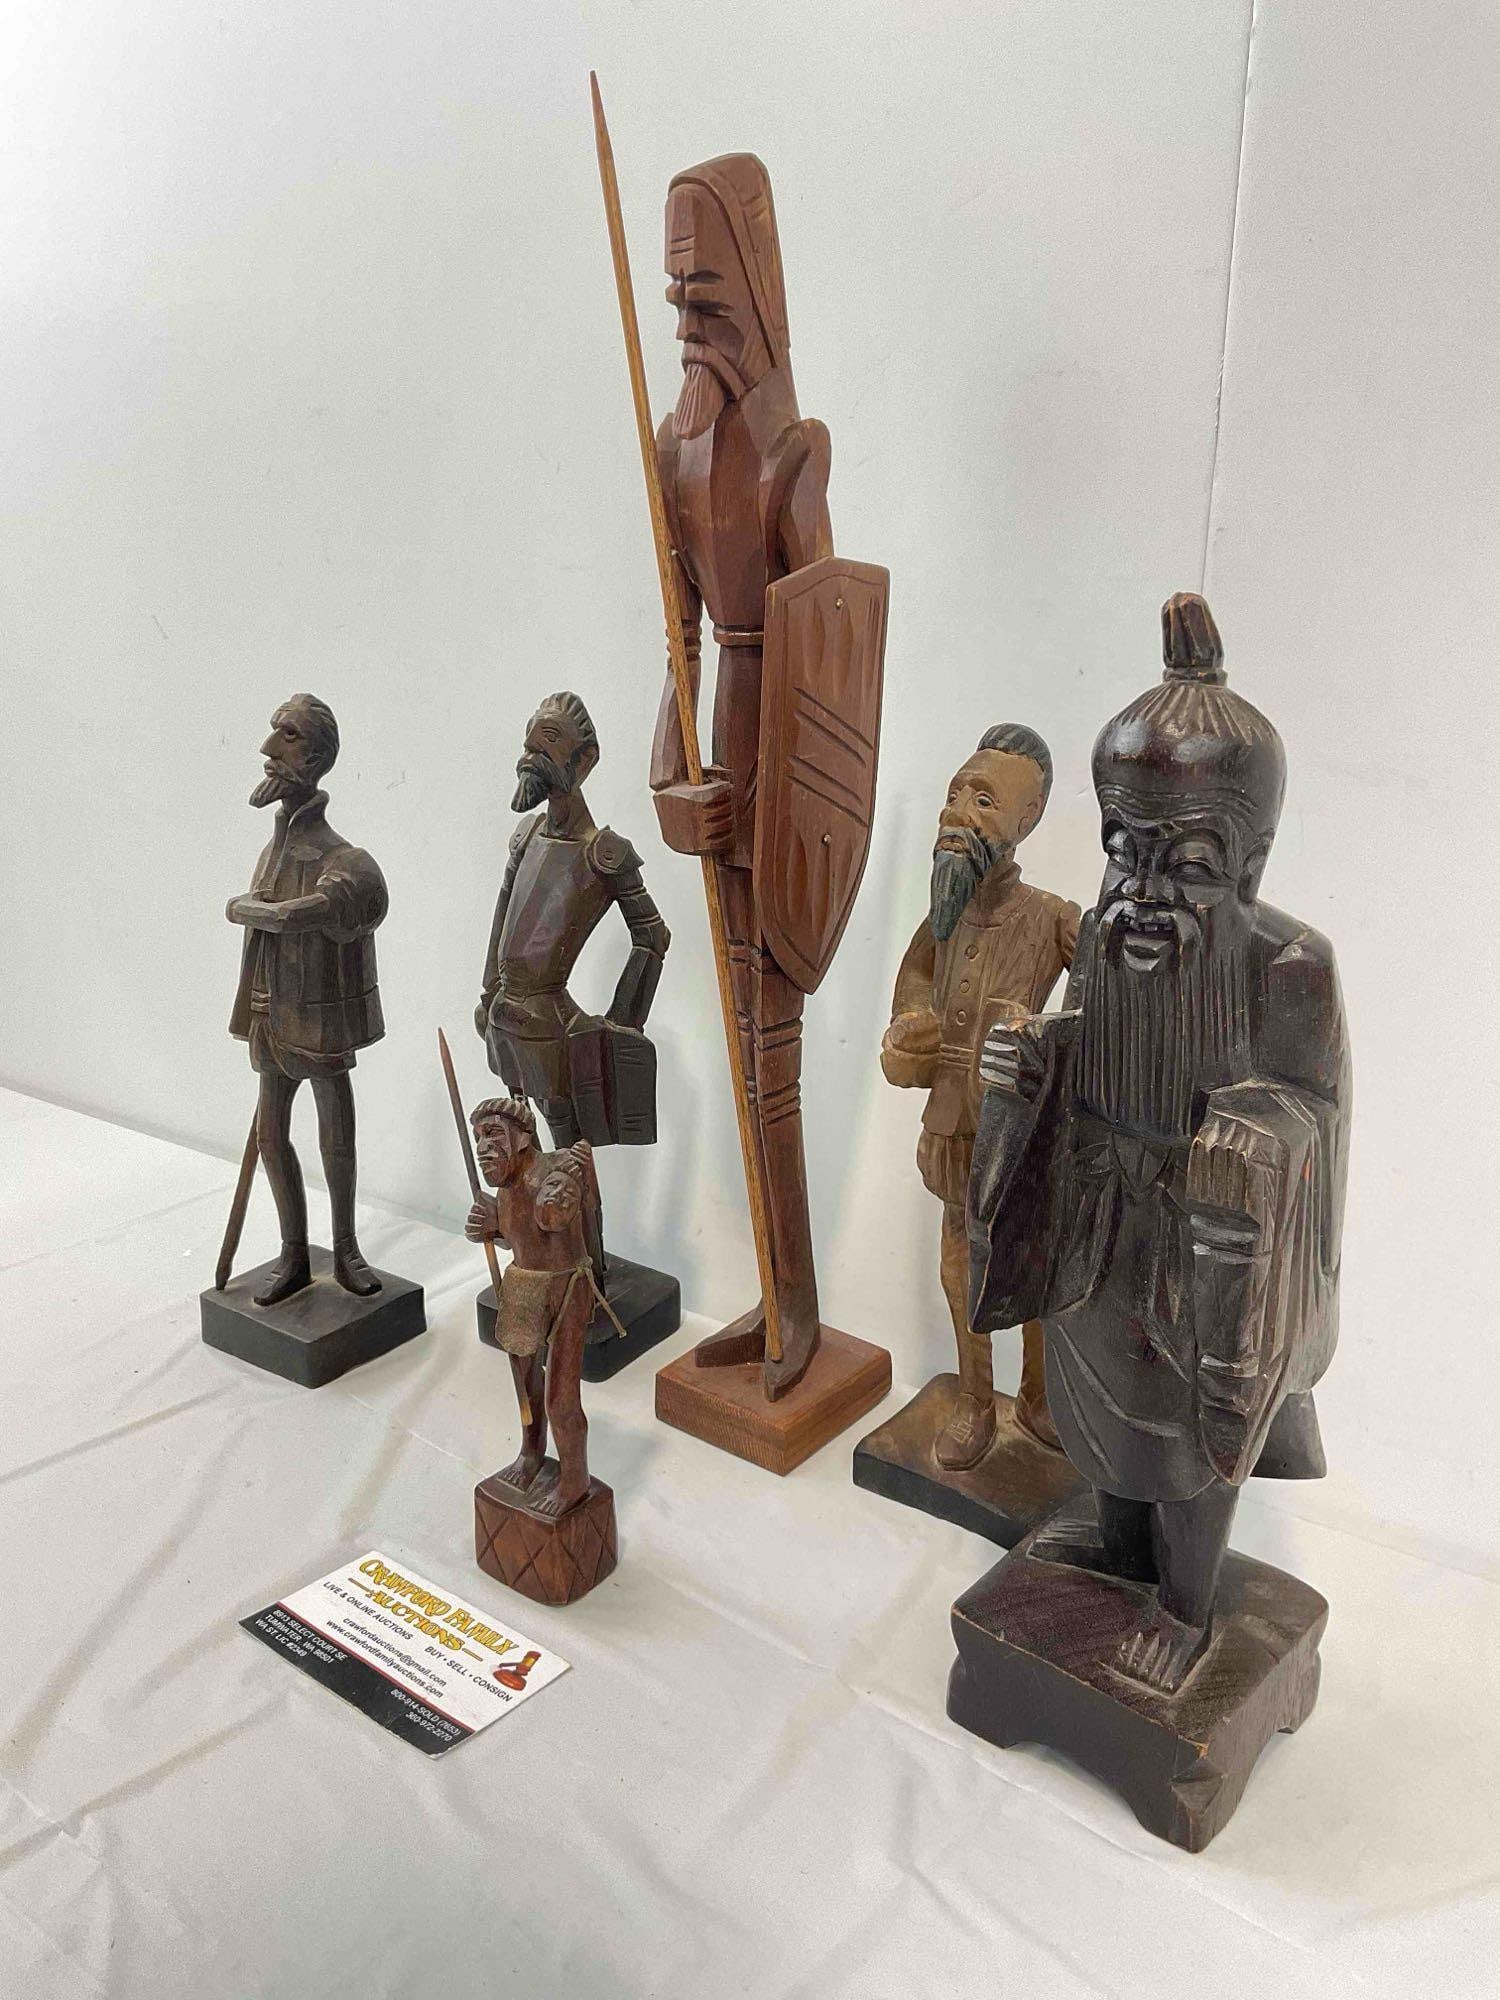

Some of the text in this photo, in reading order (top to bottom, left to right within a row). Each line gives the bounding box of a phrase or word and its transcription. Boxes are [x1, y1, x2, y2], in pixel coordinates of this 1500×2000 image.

[255, 1619, 268, 1630] WA
[266, 1627, 278, 1635] ST
[275, 1634, 289, 1644] LIC
[323, 1581, 343, 1594] LIVE
[346, 1596, 376, 1616] ONLINE
[372, 1614, 413, 1640] AUCTIONS
[359, 1559, 519, 1655] CRAWFORD FAMILY
[365, 1590, 465, 1651] AUCTIONS
[288, 1620, 315, 1639] SELECT
[312, 1636, 338, 1654] COURT
[335, 1652, 348, 1661] SE
[303, 1641, 315, 1651] WA
[326, 1620, 444, 1698] www.crawfordfamilyauctions.com
[343, 1618, 447, 1687] crawfordauctions@gmail.com
[425, 1646, 513, 1702] BUY SELL CONSIGN
